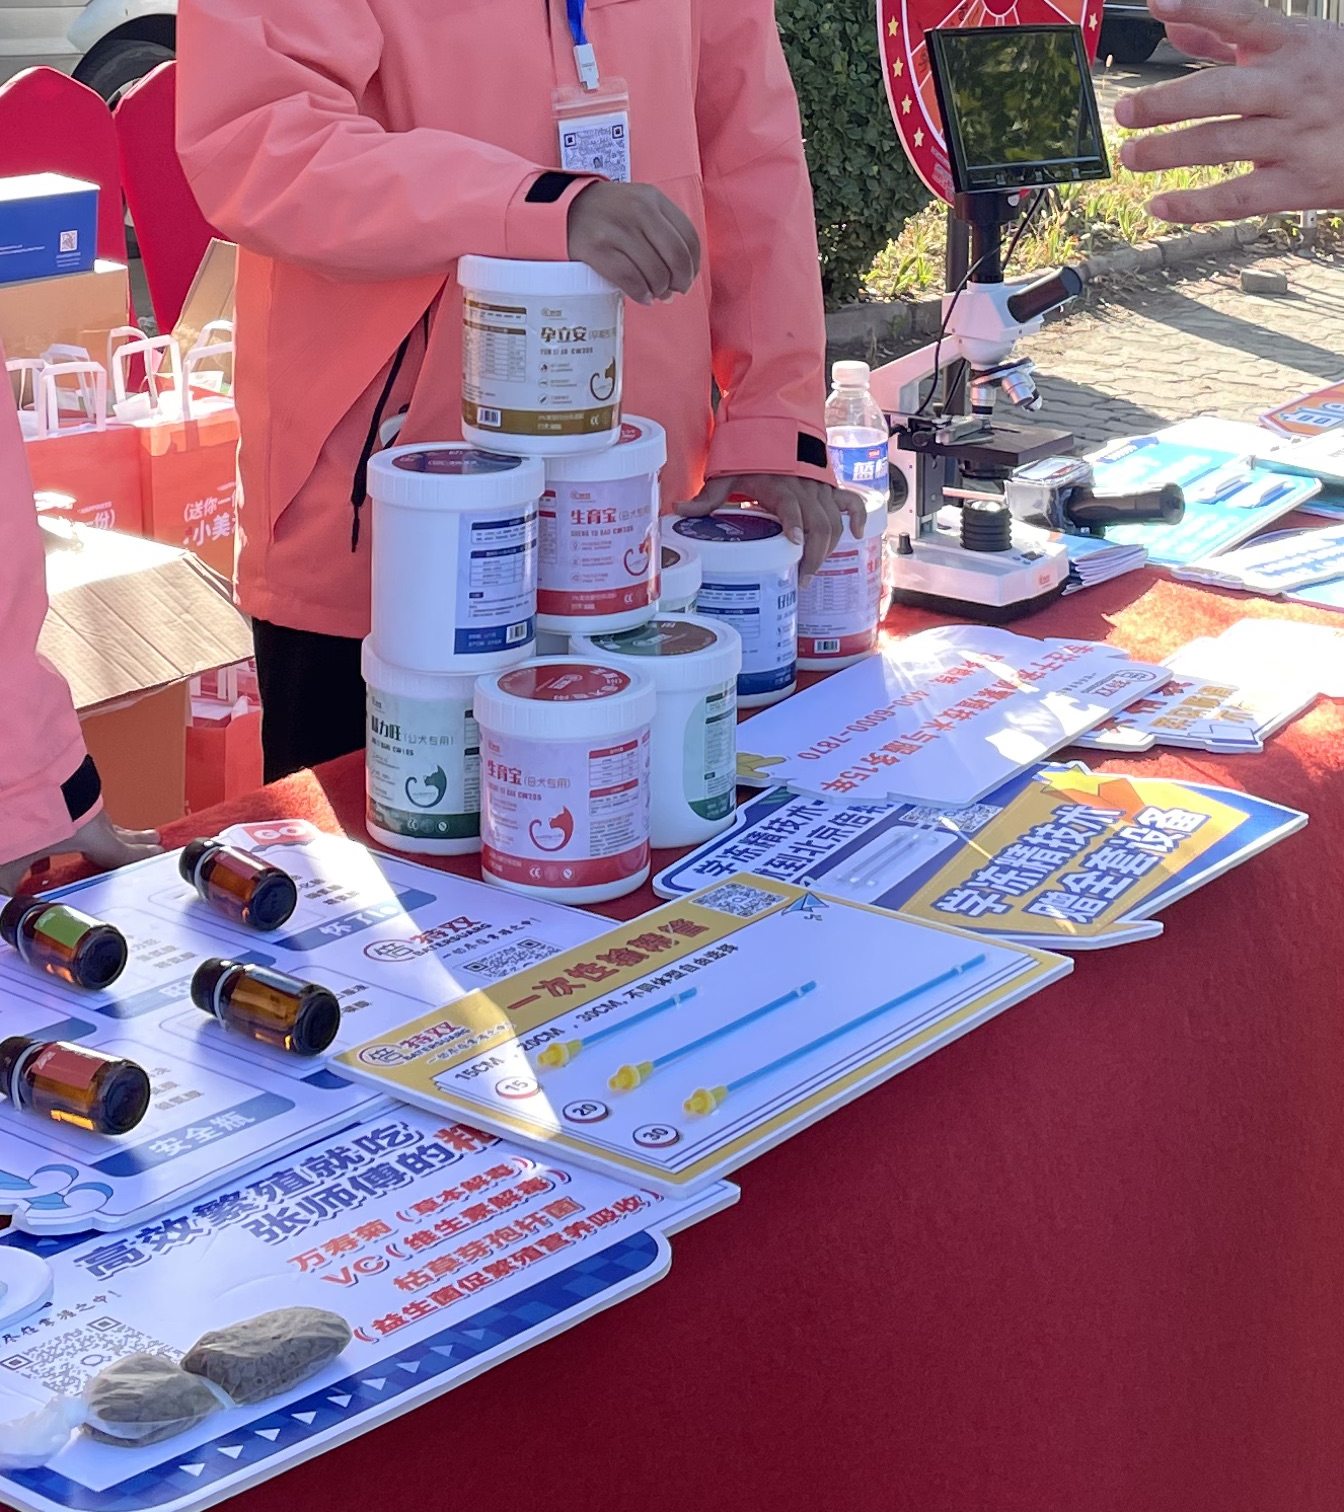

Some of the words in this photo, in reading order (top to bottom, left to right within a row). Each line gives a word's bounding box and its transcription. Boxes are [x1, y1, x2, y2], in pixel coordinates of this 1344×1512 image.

[540, 325, 587, 343] 孕立安
[570, 507, 618, 526] 生育宝
[487, 759, 523, 786] 生育宝
[934, 801, 1128, 919] 学冻精技术
[1026, 804, 1212, 926] 赠全套设备
[410, 916, 482, 945] 特双
[400, 1020, 460, 1050] 特双
[503, 1078, 531, 1095] 15
[571, 1101, 600, 1119] 20
[148, 1110, 256, 1158] 安全瓶
[641, 1126, 668, 1143] 30
[73, 1120, 425, 1280] 高效繁殖就吃
[320, 1168, 572, 1288] VC(维生素解毒)
[392, 1195, 585, 1294] 枯草芽孢杆菌
